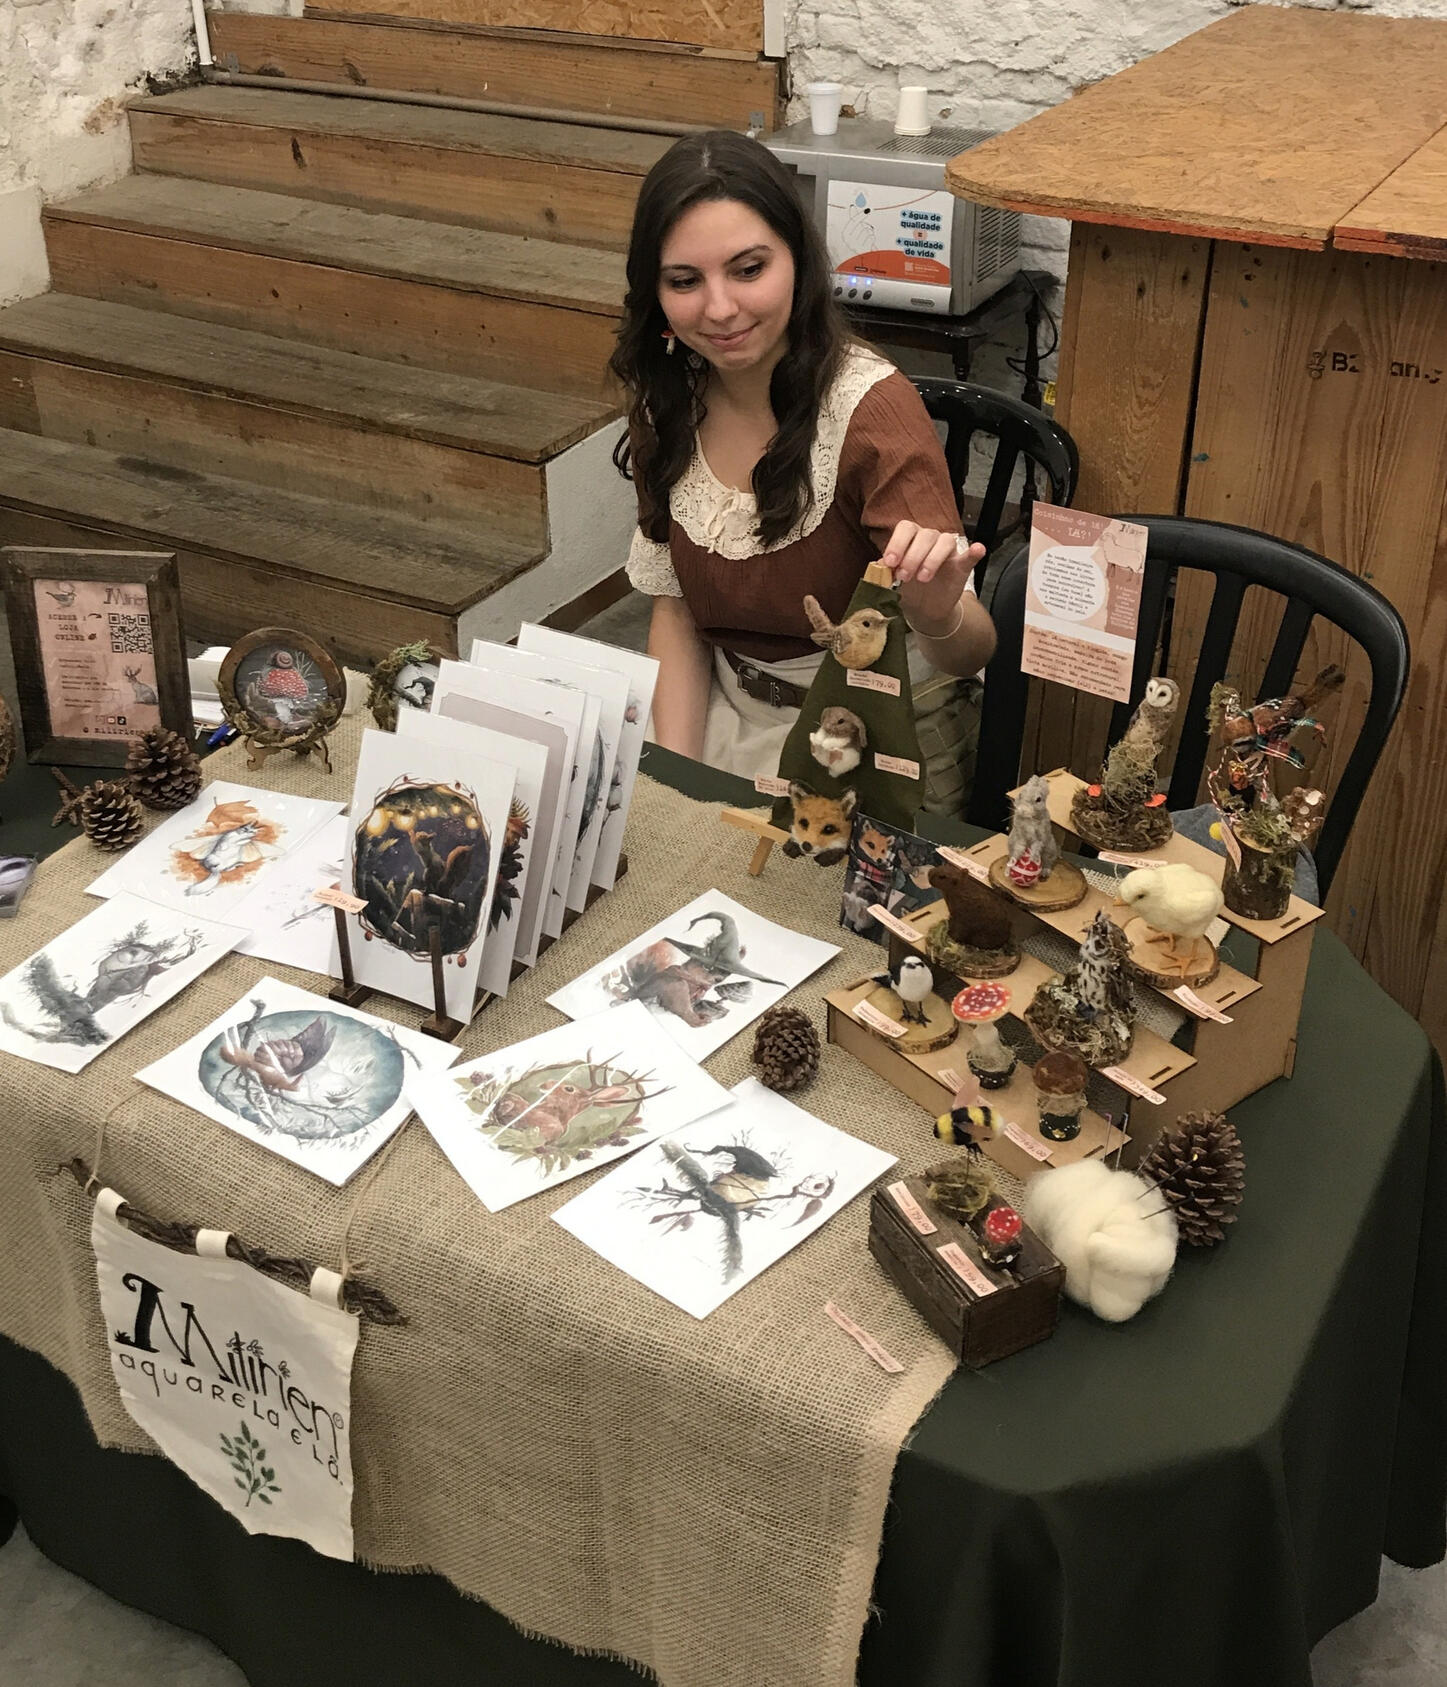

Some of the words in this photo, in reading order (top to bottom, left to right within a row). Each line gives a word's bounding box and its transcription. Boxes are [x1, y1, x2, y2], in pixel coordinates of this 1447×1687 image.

[908, 210, 928, 221] água
[931, 213, 941, 221] de
[900, 220, 941, 232] qualidade
[903, 238, 944, 251] qualidade
[904, 249, 916, 257] de
[917, 249, 935, 259] vida
[58, 623, 80, 632] LOJA
[54, 633, 86, 642] ONLINE
